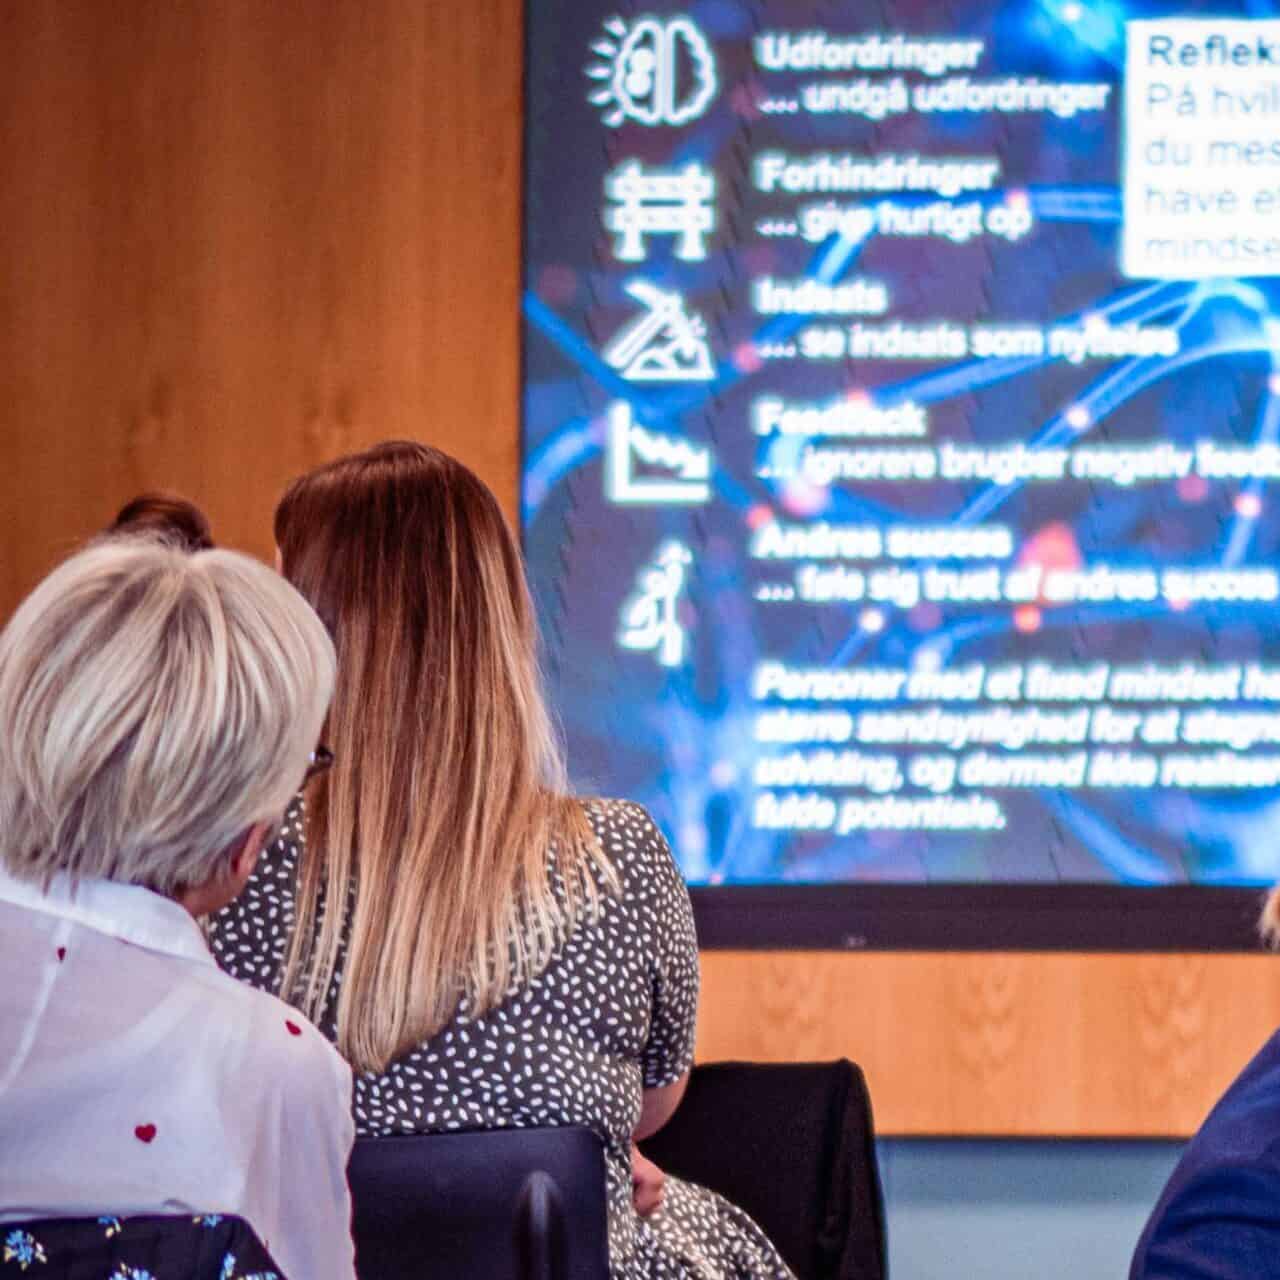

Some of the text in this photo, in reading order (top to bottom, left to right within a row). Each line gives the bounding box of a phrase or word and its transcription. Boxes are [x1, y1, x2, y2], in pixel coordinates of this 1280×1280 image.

[757, 33, 984, 73] Udfordringer
[803, 80, 908, 117] undgå
[912, 80, 1109, 117] udfordringer
[1146, 81, 1196, 117] På
[1145, 136, 1191, 166] du
[756, 156, 1000, 193] Forhindringer
[1144, 184, 1239, 214] have
[880, 202, 983, 240] hurtigt
[988, 206, 1030, 241] op
[755, 280, 887, 313] Indsats
[849, 323, 967, 357] indsats
[970, 327, 1043, 357] som
[802, 446, 935, 485] ignorere
[940, 444, 1066, 484] brugbar
[1072, 442, 1192, 485] negativ
[1161, 570, 1278, 601] succes
